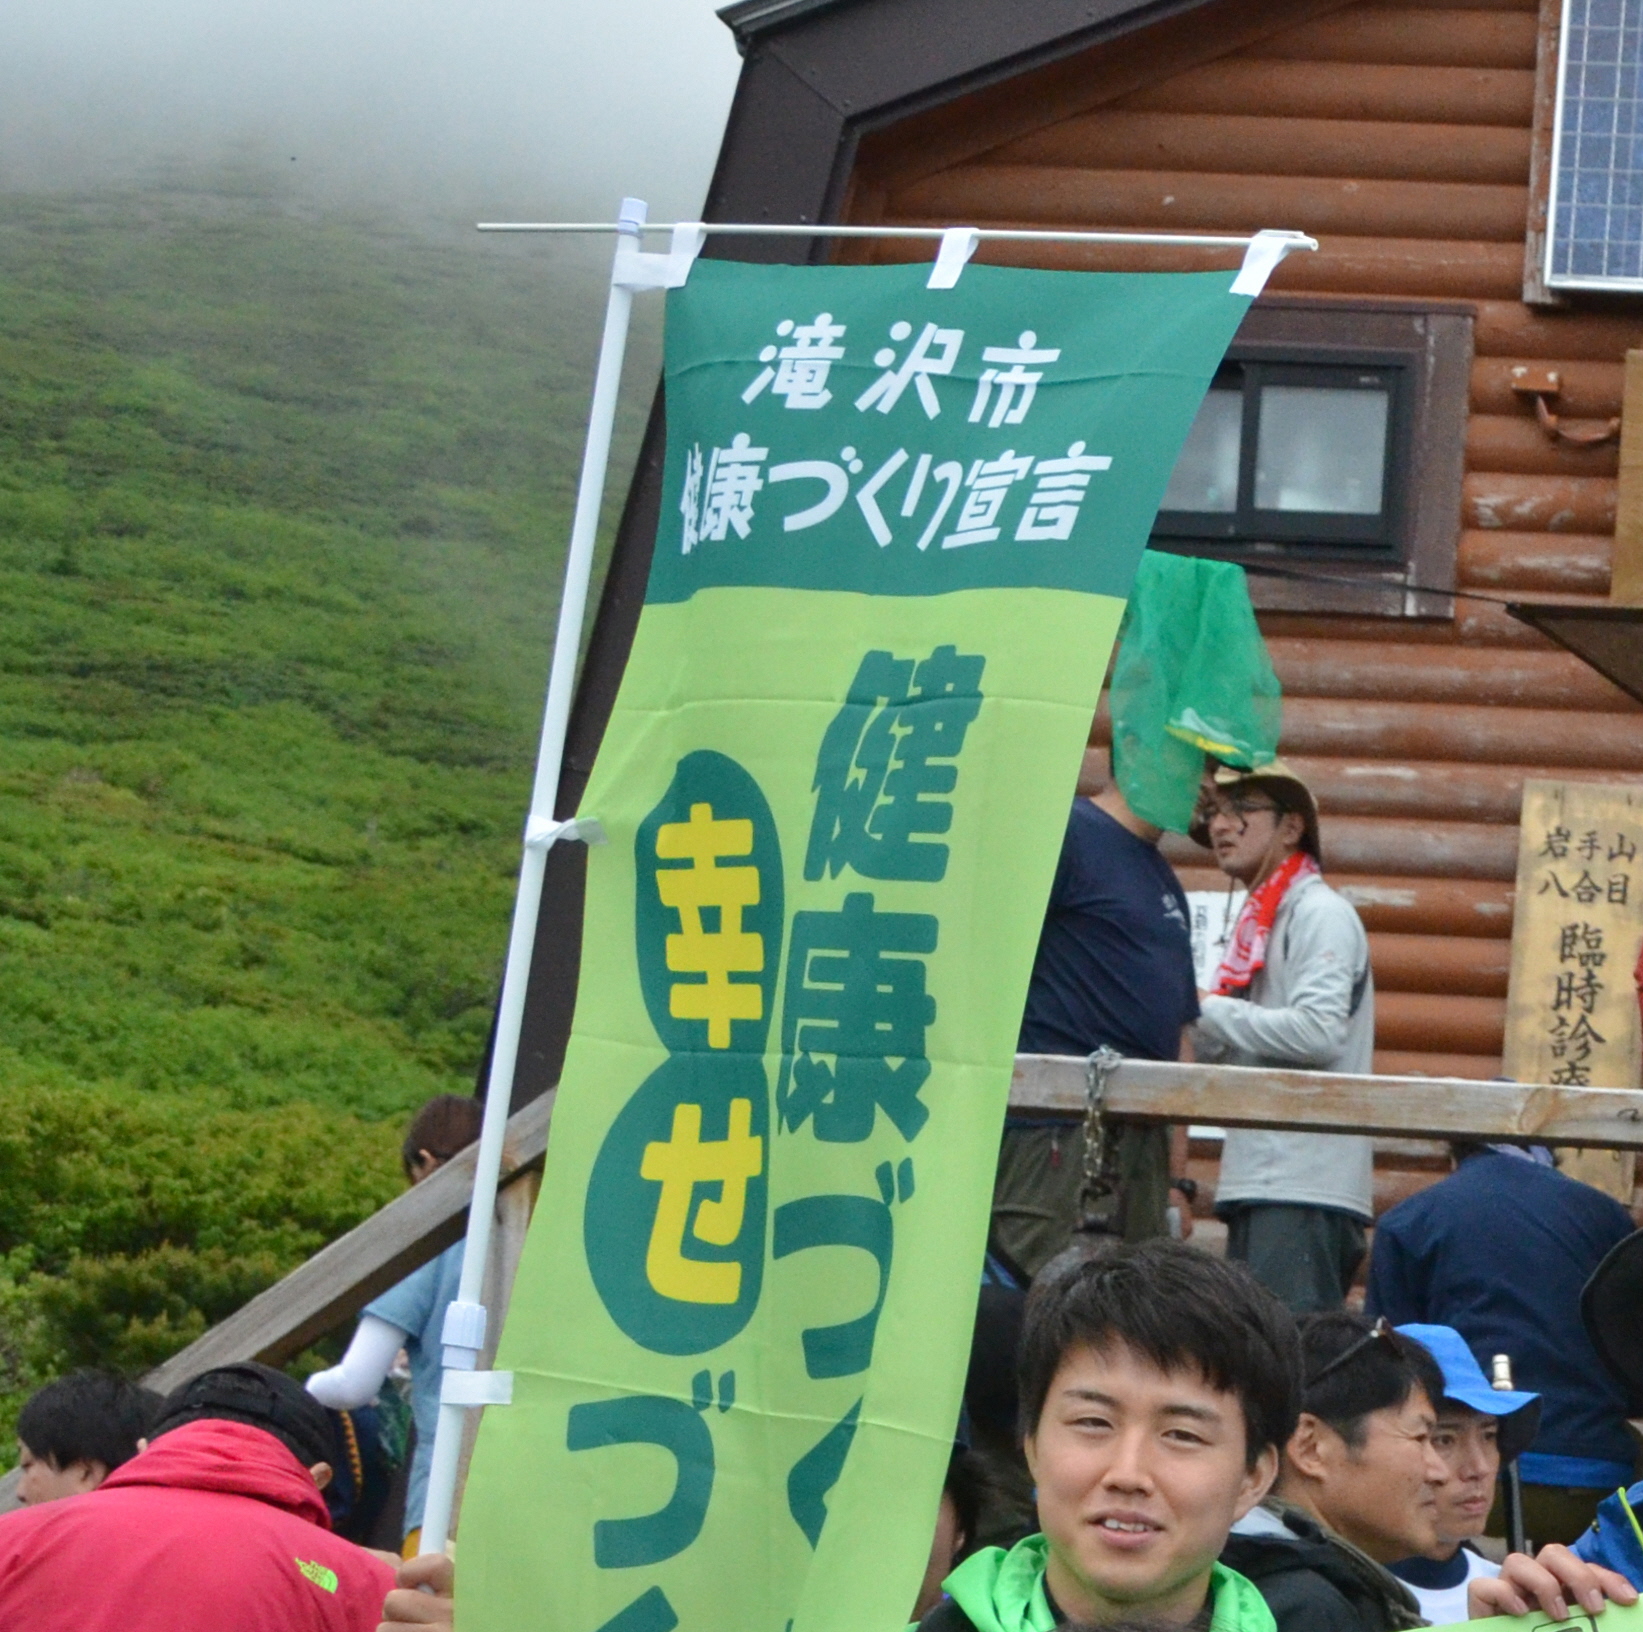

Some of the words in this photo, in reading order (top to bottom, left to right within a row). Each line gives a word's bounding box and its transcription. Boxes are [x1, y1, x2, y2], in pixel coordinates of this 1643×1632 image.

[741, 312, 1061, 428] 滝沢市
[680, 433, 1112, 554] 健康づくり宣言
[1538, 827, 1637, 863] 岩手山
[1538, 871, 1631, 905] 八合目
